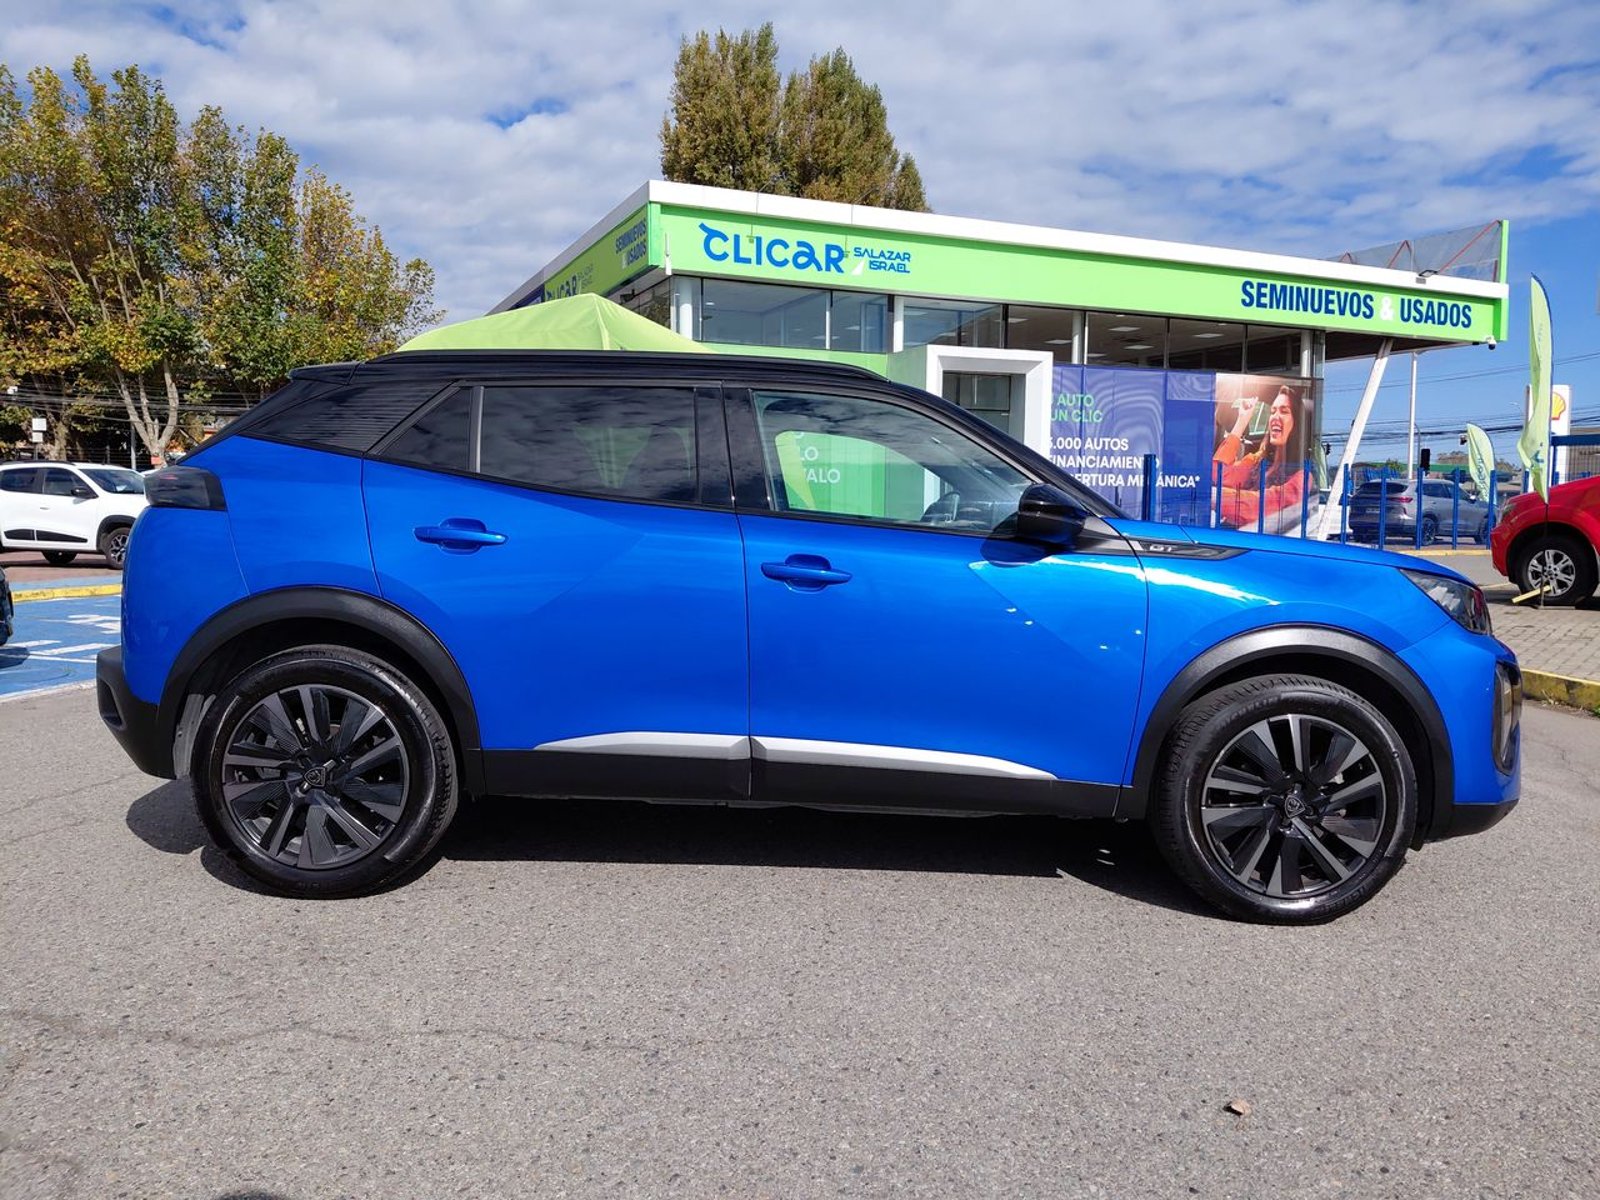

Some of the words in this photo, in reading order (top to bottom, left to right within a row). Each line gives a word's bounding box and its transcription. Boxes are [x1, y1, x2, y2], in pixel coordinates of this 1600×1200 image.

[853, 247, 911, 262] SALAZAR
[1241, 280, 1374, 319] SEMINUEVOS
[1379, 296, 1394, 321] &
[1400, 298, 1472, 328] USADOS
[1057, 393, 1095, 407] AUTO
[1071, 410, 1104, 423] CLIC
[1084, 437, 1129, 450] AUTOS
